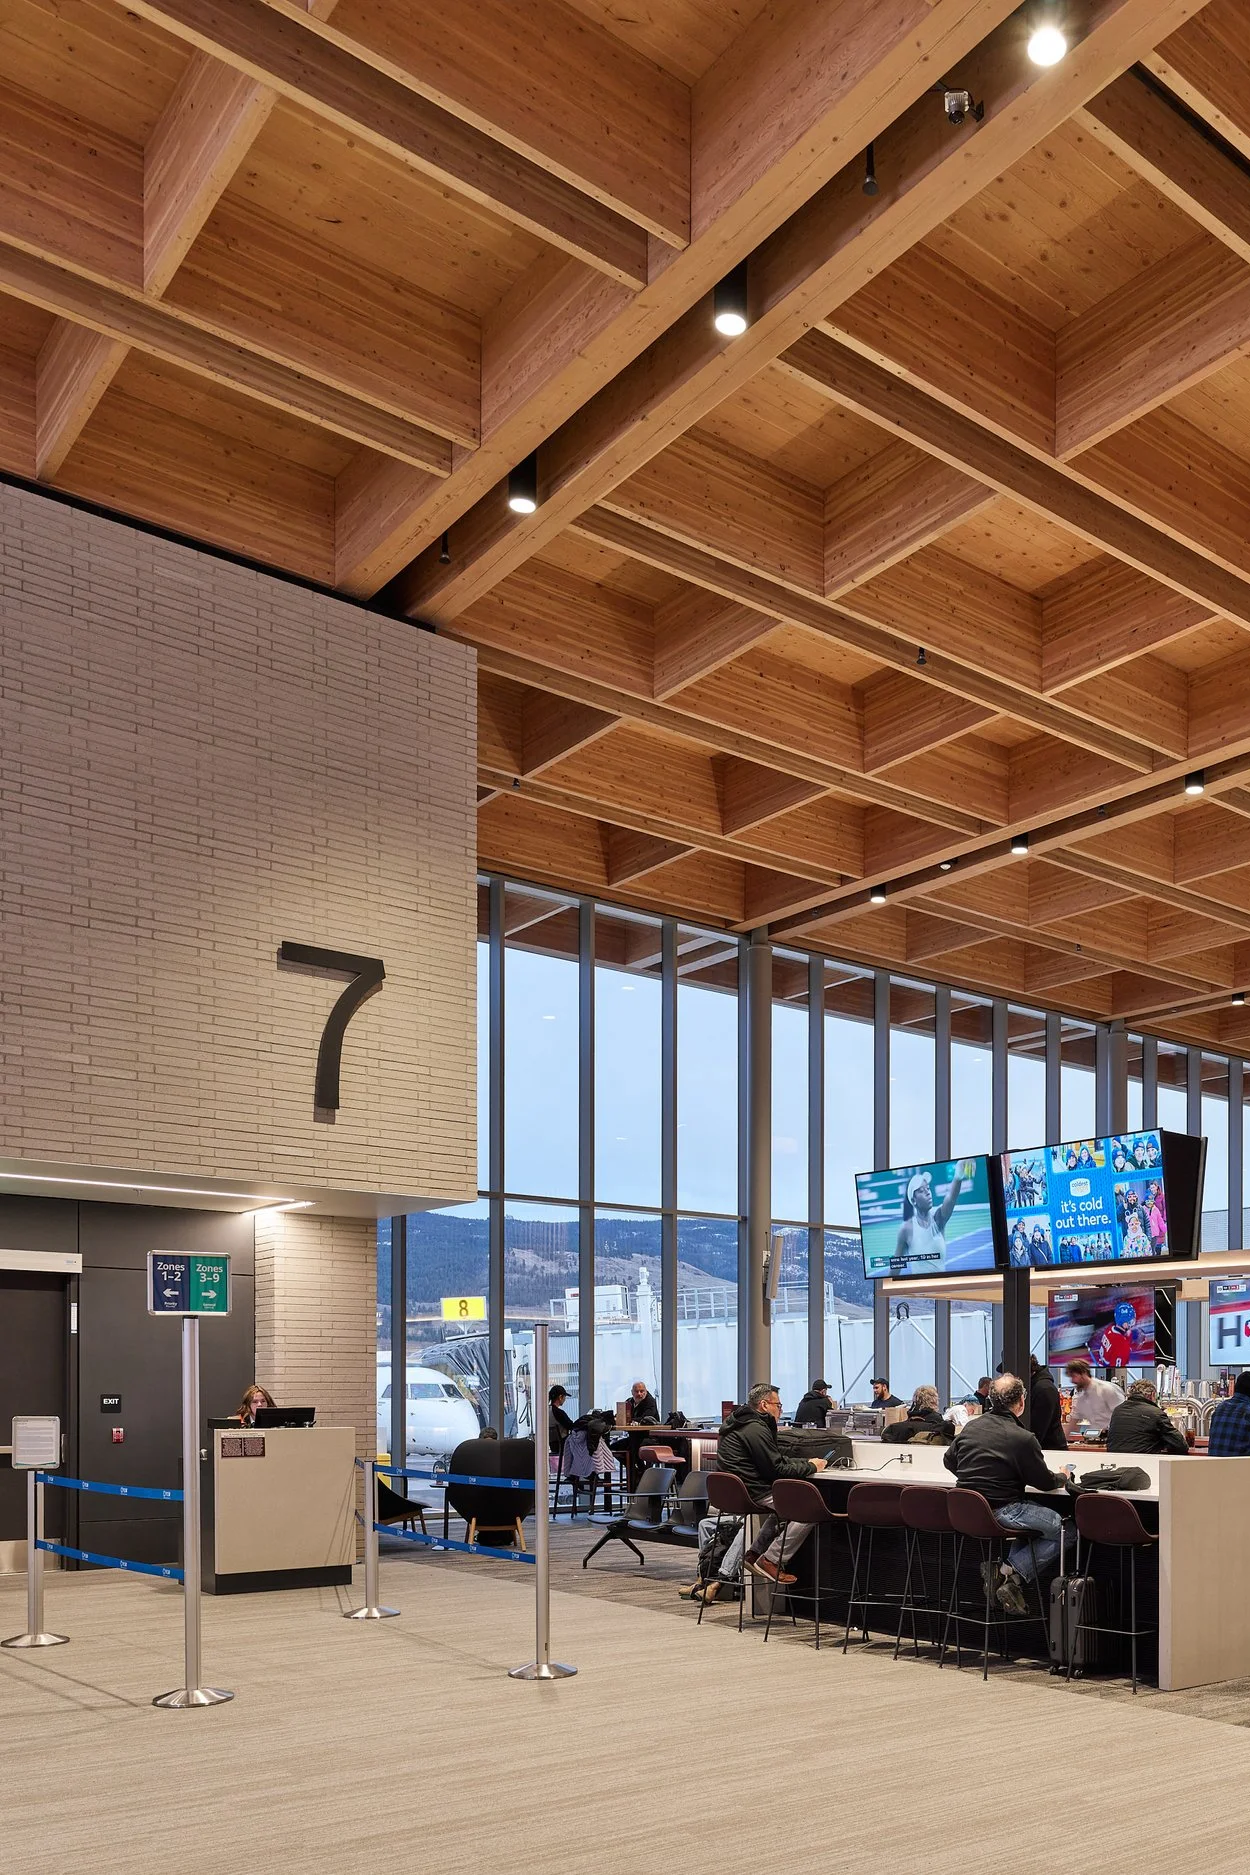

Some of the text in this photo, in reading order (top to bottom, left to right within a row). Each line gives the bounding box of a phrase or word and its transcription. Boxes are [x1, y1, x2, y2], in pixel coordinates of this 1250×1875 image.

[282, 941, 386, 1109] 7
[1060, 1196, 1103, 1213] it's cold
[1055, 1214, 1112, 1229] out there.
[157, 1262, 185, 1271] Zones
[196, 1264, 223, 1273] Zones
[459, 1300, 469, 1317] 8
